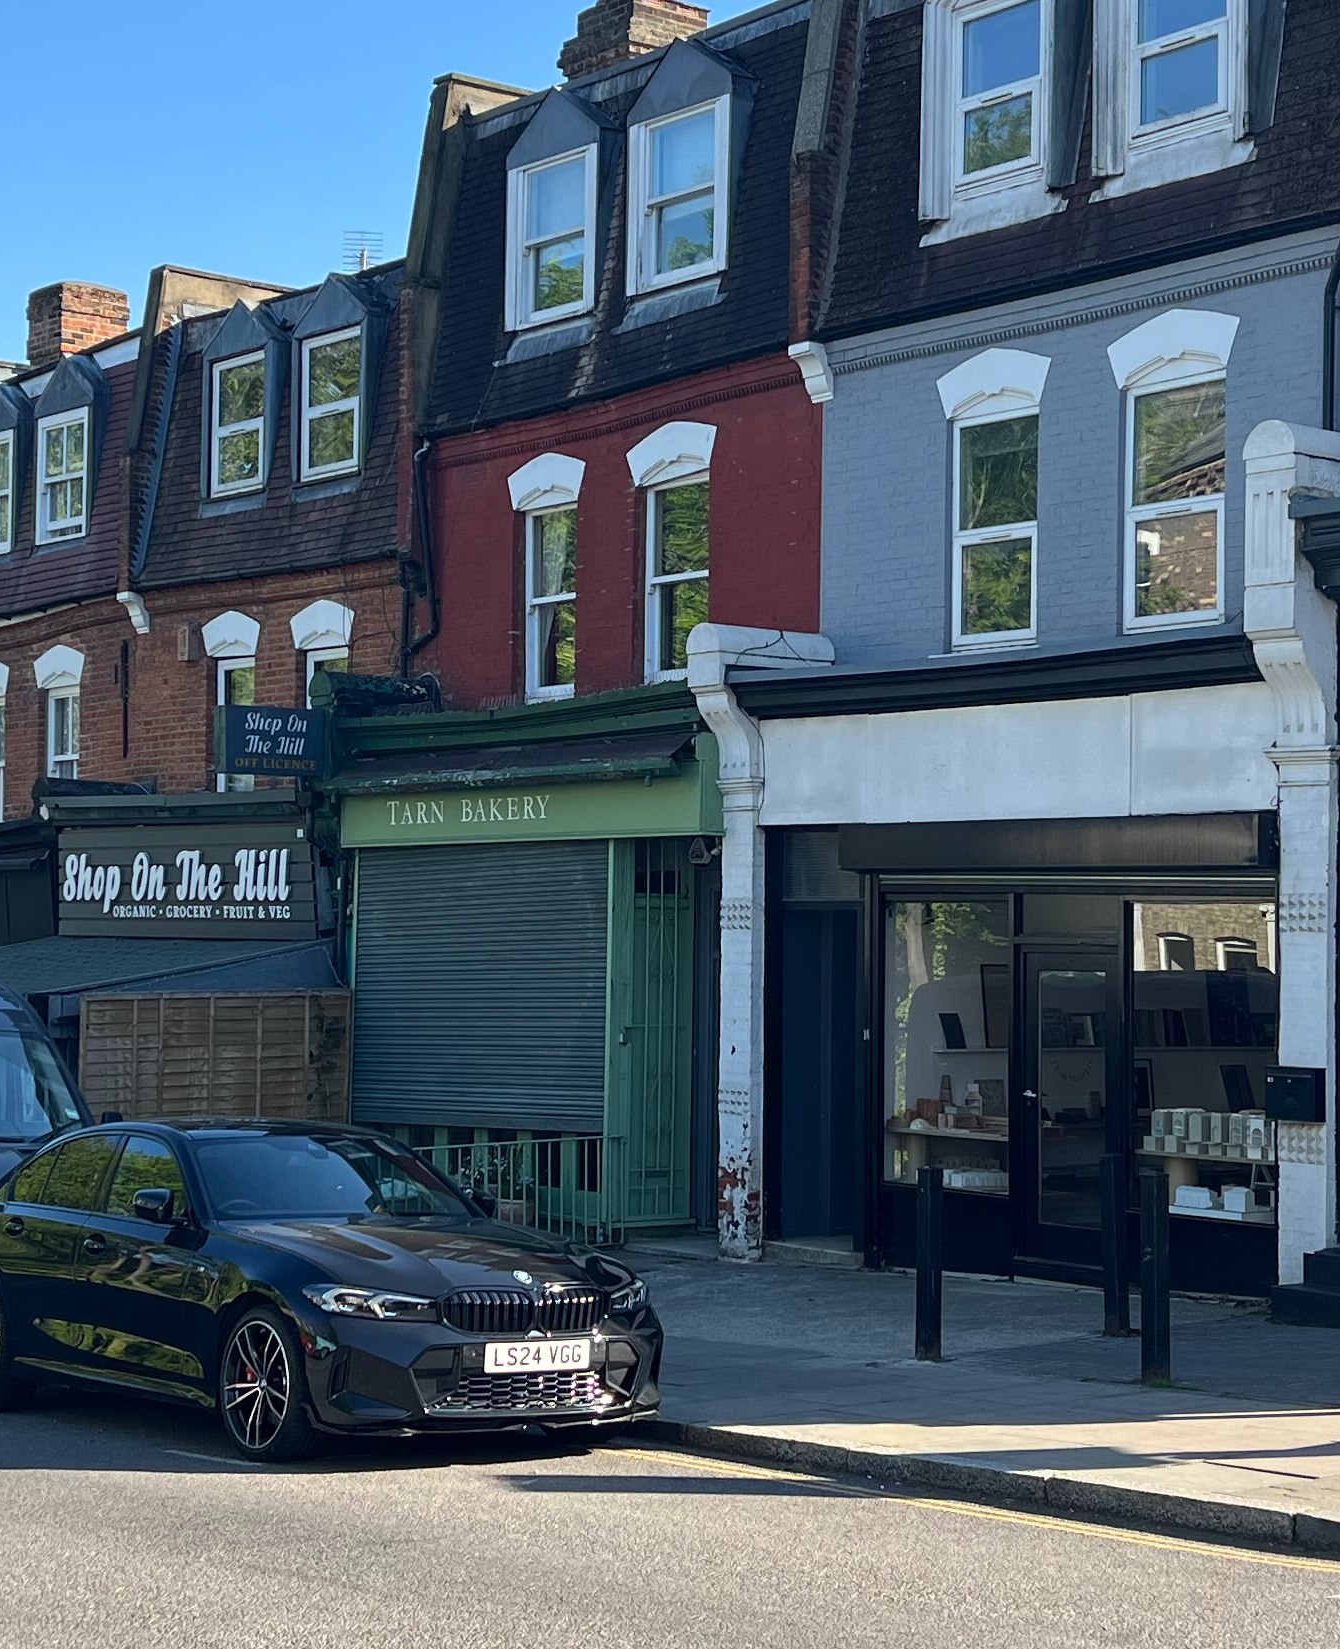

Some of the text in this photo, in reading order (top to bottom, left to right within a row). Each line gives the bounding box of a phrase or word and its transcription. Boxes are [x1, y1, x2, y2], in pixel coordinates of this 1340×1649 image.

[245, 712, 308, 736] Shop On
[245, 735, 305, 756] The Hill
[234, 757, 317, 771] OFF LICENCE
[386, 794, 551, 826] TARN BAKERY
[62, 848, 292, 914] Shop On The Hill
[112, 905, 291, 919] ORGANIC GROCERY FRUIT & VEG
[493, 1344, 582, 1367] LS24 VGG
